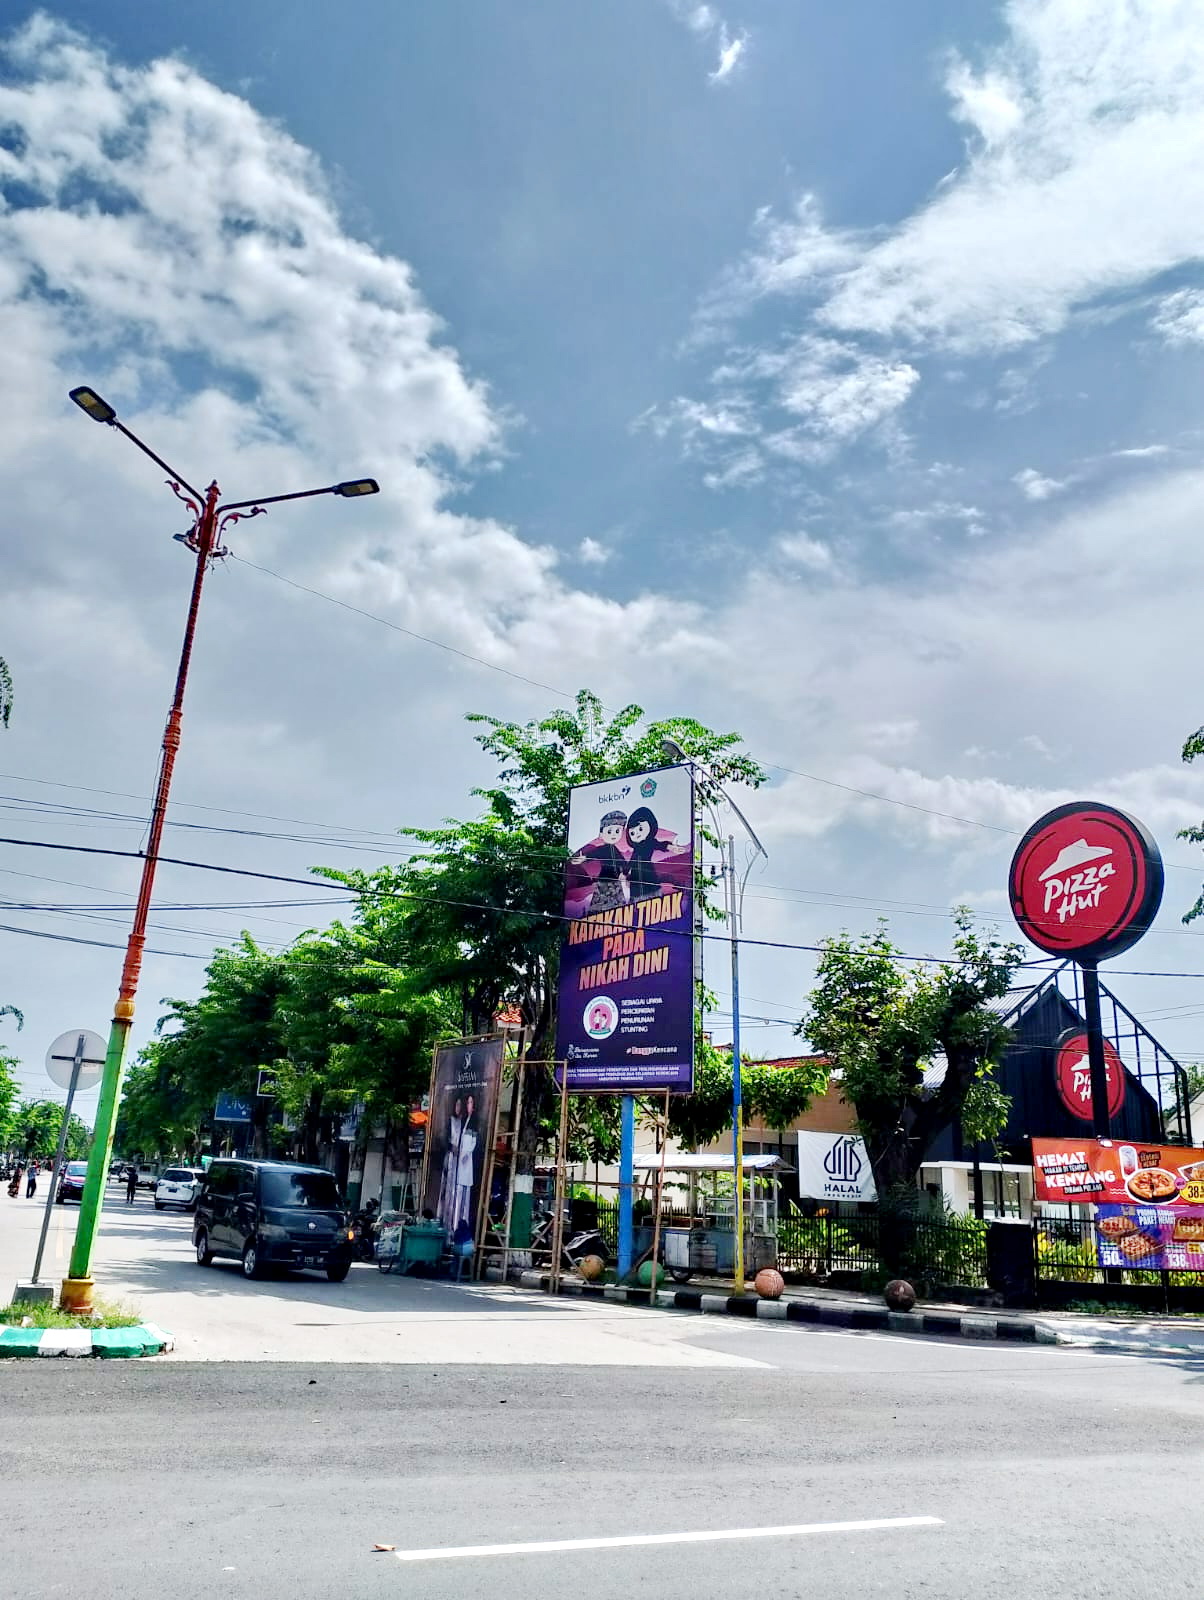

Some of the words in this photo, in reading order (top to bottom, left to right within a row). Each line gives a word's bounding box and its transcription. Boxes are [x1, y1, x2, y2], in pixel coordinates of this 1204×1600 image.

[598, 793, 625, 804] bkkbn
[1044, 862, 1116, 913] Pizza
[1056, 885, 1109, 923] Hut
[569, 904, 634, 946] KATAKAN
[636, 892, 683, 928] TIDAK
[603, 929, 645, 960] PADA
[579, 956, 630, 991] NIKAH
[633, 946, 669, 978] DINI
[621, 1025, 648, 1033] STUNTING
[1036, 1151, 1086, 1168] HEMAT
[824, 1183, 862, 1194] HALAL
[1045, 1170, 1116, 1188] KENYANG
